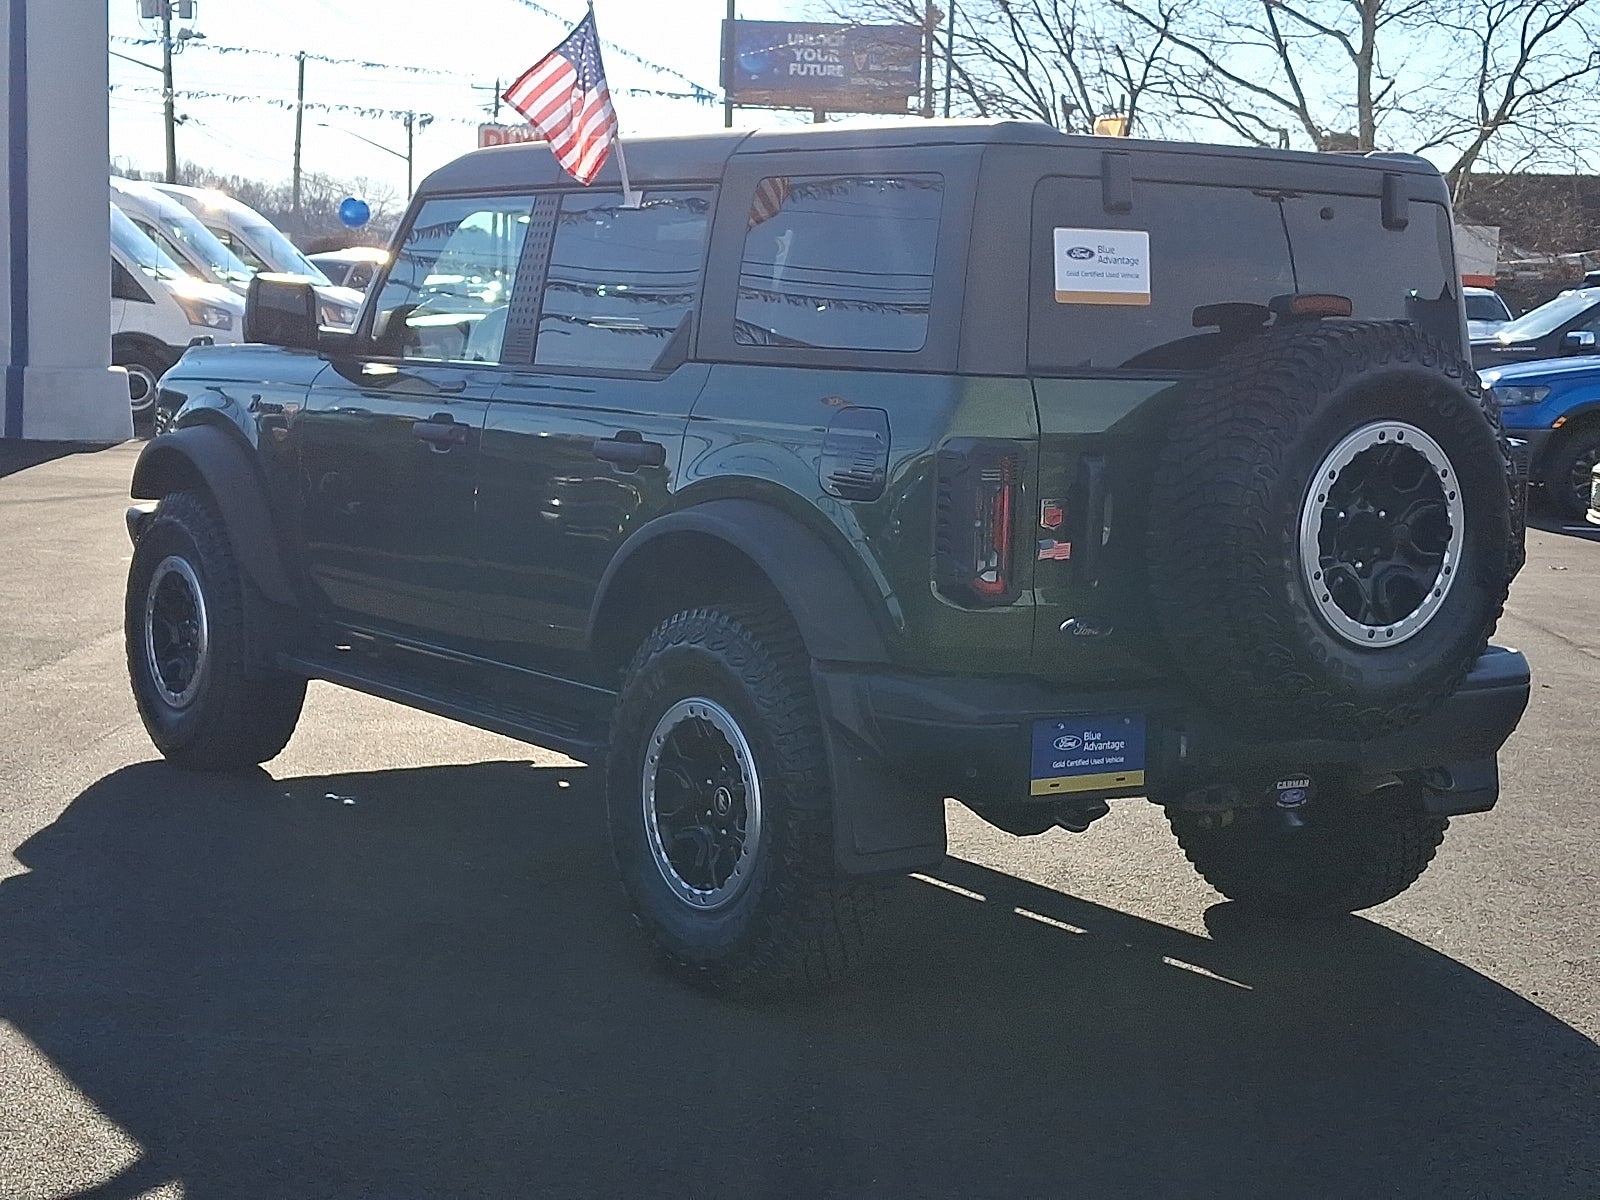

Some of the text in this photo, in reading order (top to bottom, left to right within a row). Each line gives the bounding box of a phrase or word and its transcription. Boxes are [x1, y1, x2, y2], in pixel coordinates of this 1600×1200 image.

[791, 48, 840, 63] YOUR
[788, 63, 844, 77] FUTURE
[1097, 245, 1115, 254] Blue
[1097, 255, 1140, 266] Advantage
[1081, 270, 1105, 278] Certified
[1083, 731, 1101, 741] Blue
[1083, 740, 1125, 751] Advantage
[1052, 756, 1125, 768] Gold Certified Used Vehicle
[1276, 779, 1310, 789] CARMAN
